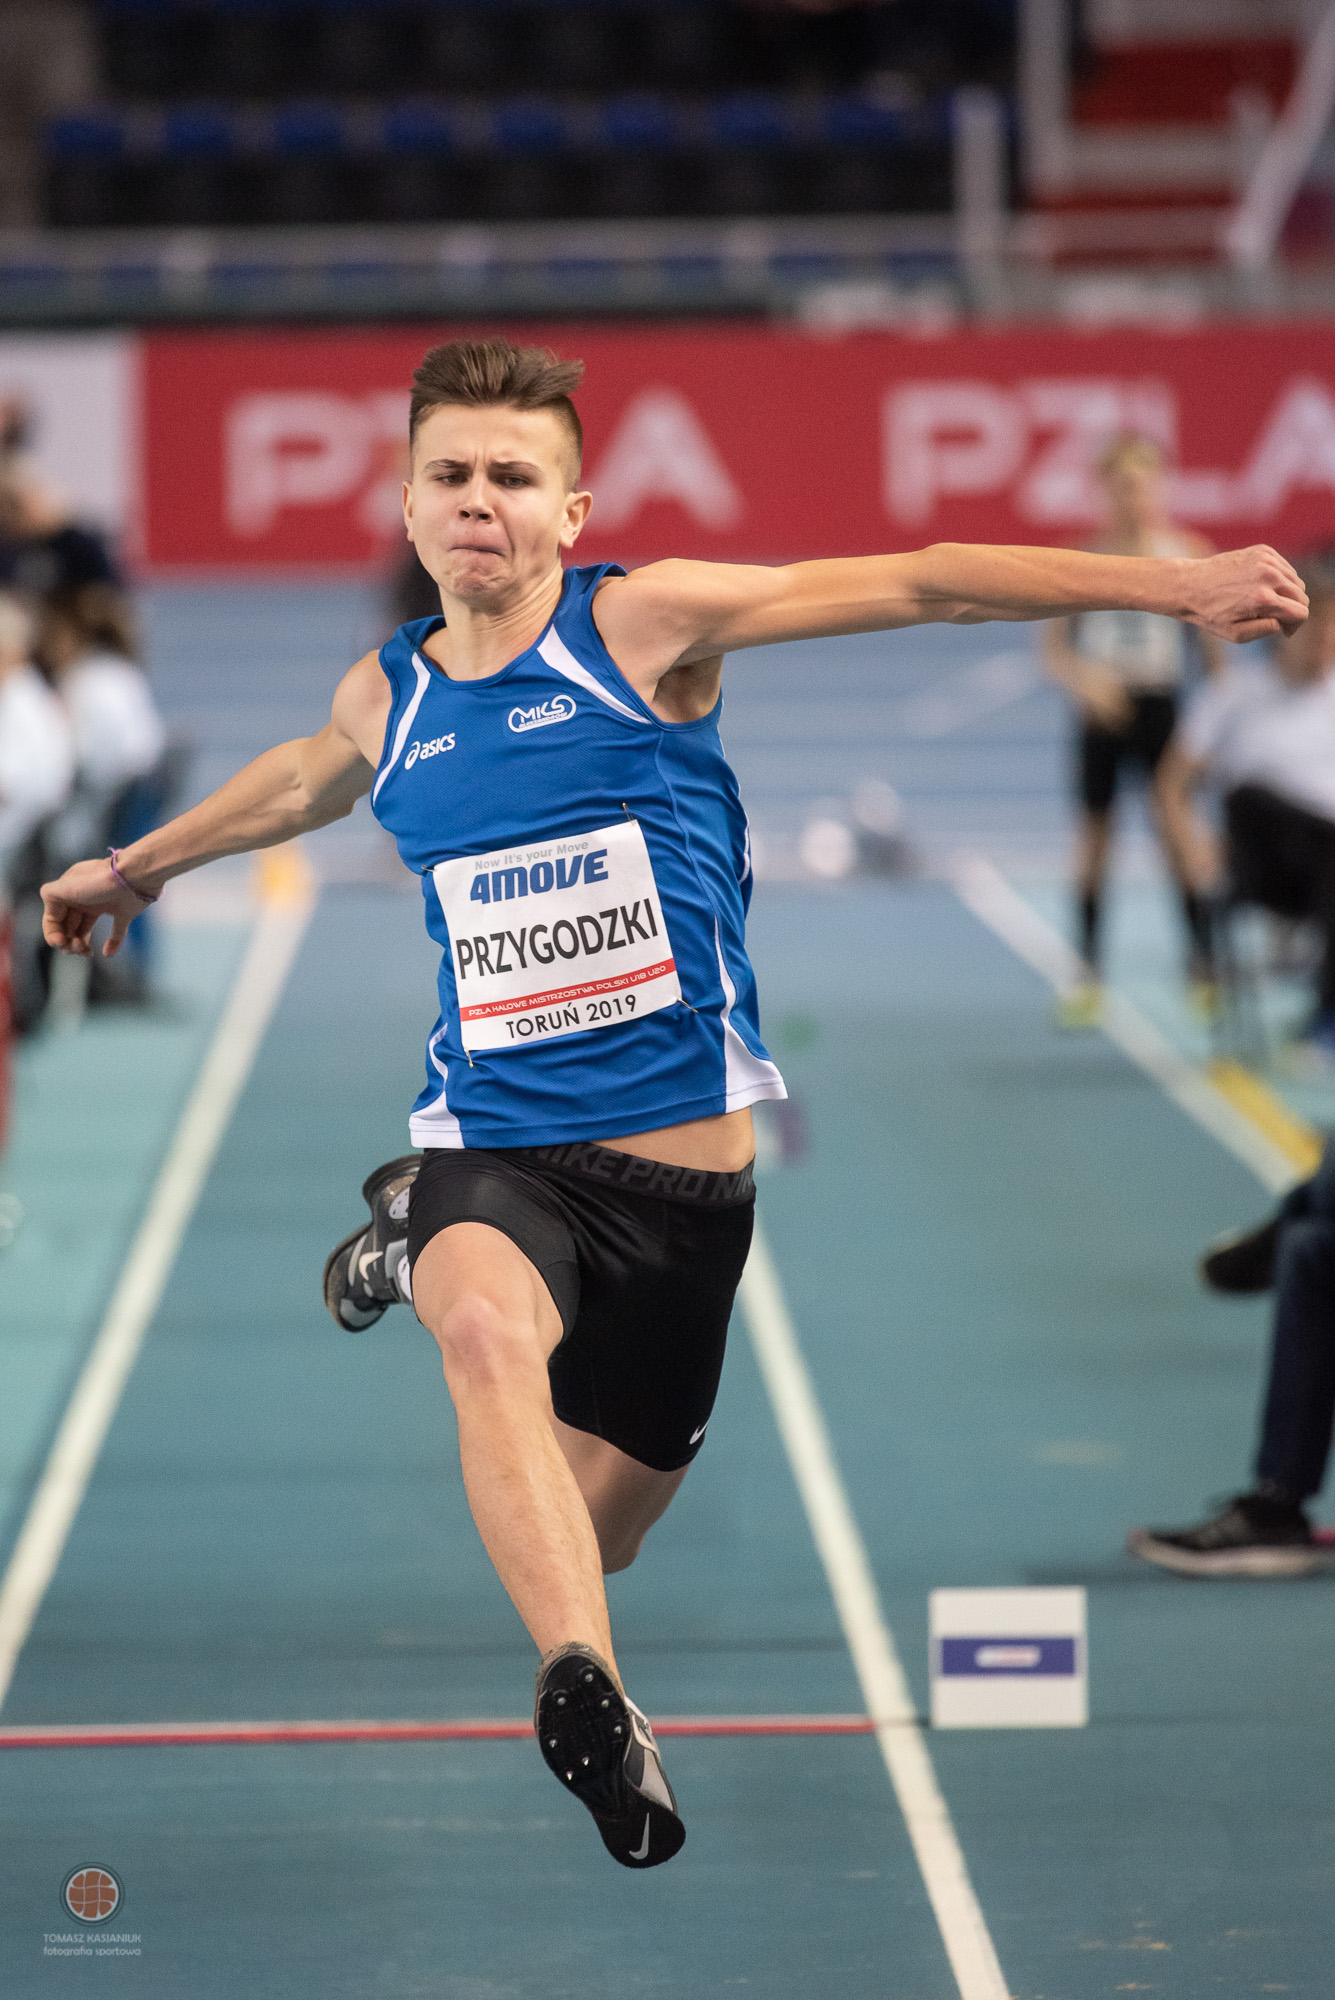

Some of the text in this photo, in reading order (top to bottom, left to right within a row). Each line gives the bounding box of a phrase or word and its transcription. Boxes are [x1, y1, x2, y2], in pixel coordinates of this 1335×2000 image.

[224, 387, 740, 538] PA
[511, 696, 572, 727] MKS
[474, 841, 589, 871] Now It's your Move
[455, 898, 659, 980] PRZYGODZKI
[468, 965, 667, 1017] PZLA HALOWE MISTRZOSTWA POLSKI U18 U20
[506, 994, 636, 1038] TORUŃ 2019
[620, 1156, 707, 1198] PRO
